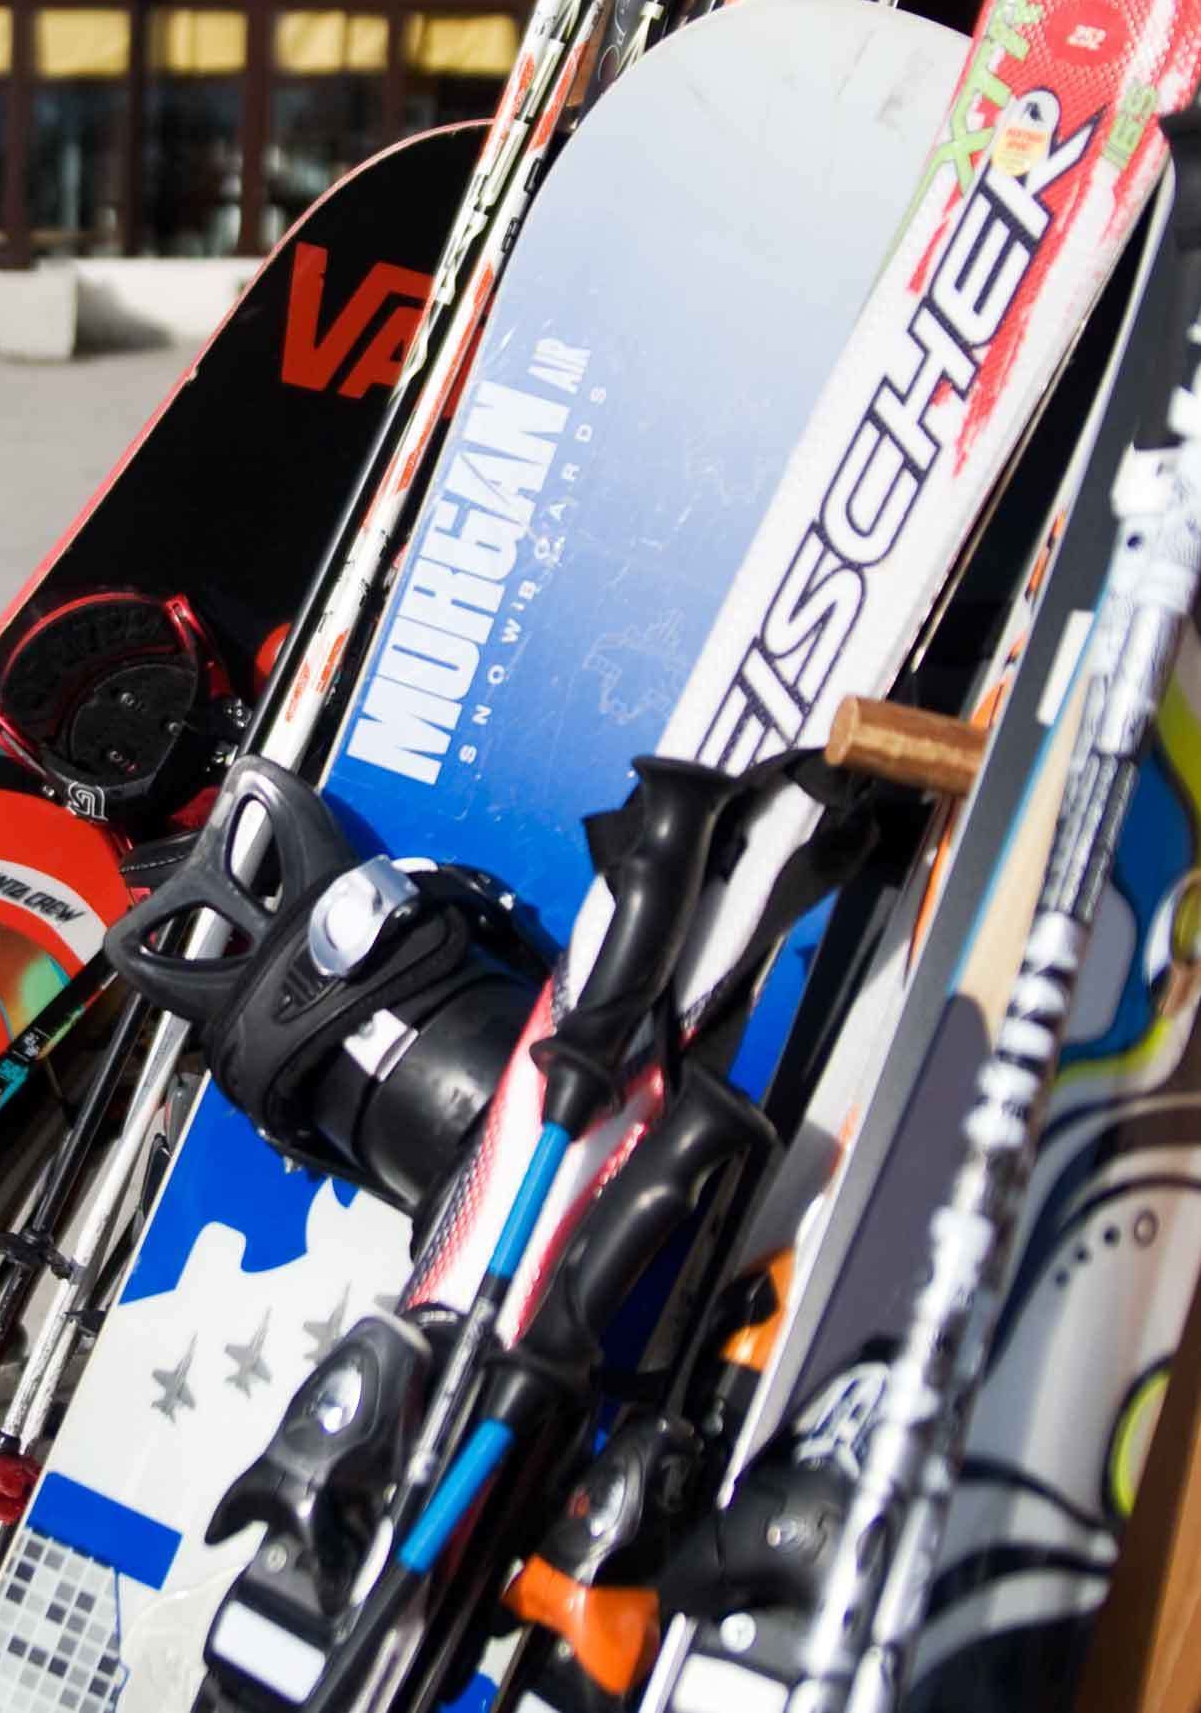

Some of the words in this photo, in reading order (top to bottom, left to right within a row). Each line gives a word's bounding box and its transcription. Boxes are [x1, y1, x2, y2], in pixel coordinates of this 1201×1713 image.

[347, 380, 572, 785] MORGAN
[527, 336, 592, 394] AIR
[693, 86, 1109, 778] FISCHER
